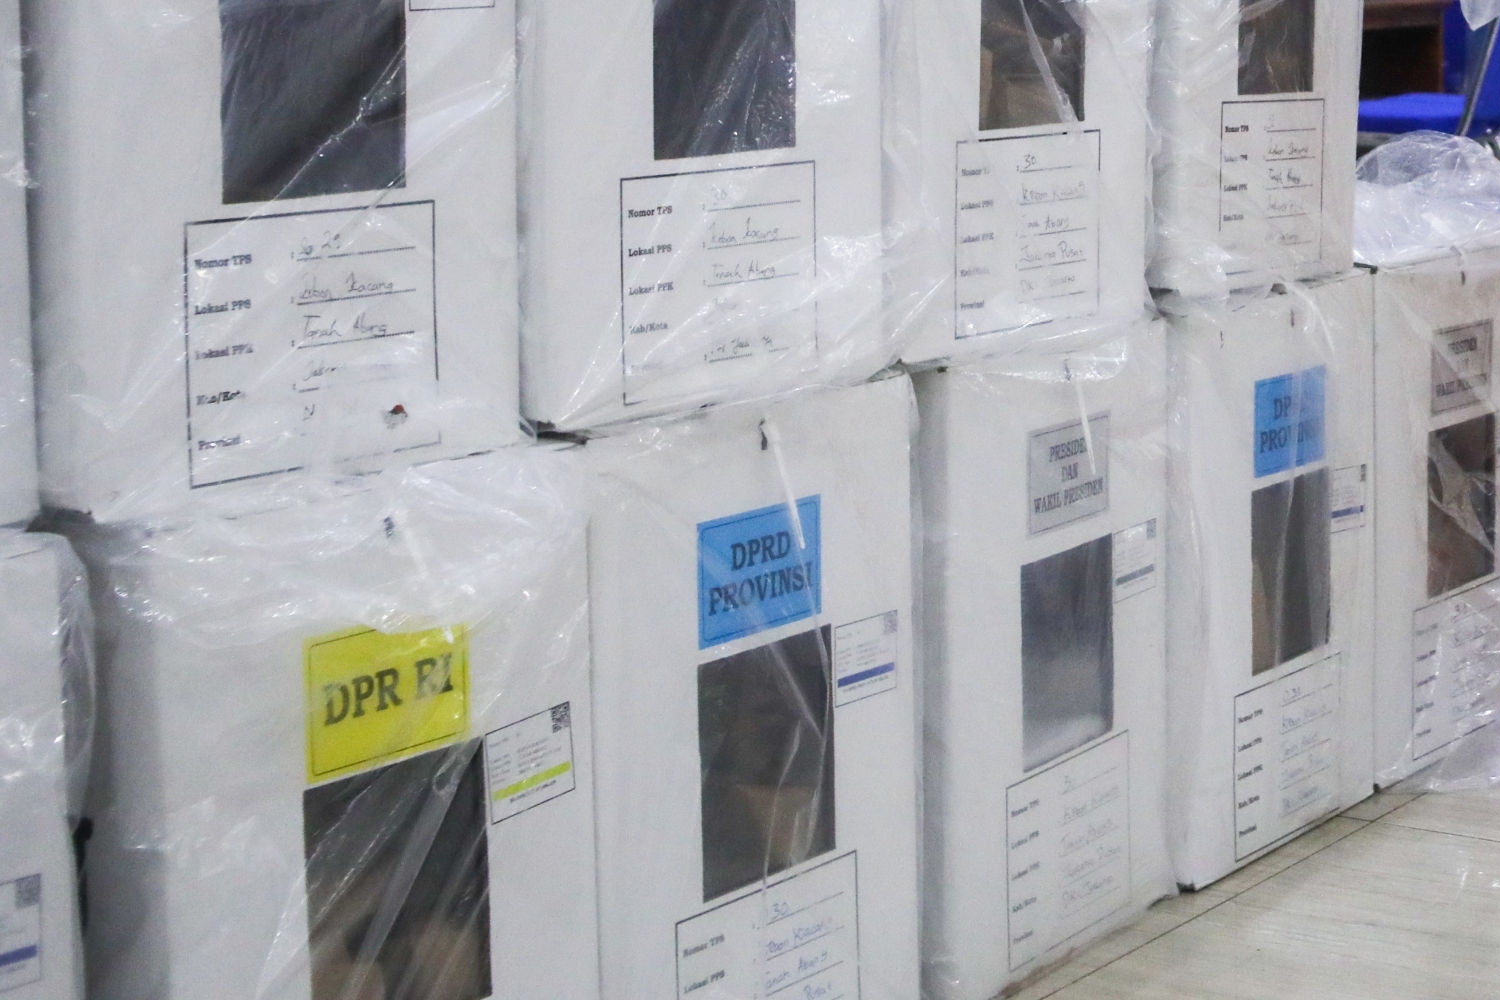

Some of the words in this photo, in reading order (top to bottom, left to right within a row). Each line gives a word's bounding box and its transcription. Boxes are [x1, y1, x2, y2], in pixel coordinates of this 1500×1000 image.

[627, 208, 655, 219] Nomor
[628, 245, 655, 258] Lokasi
[656, 243, 673, 255] PPS
[1048, 436, 1090, 463] PRESIDE
[1061, 462, 1079, 482] DAN
[730, 530, 791, 572] DPRD
[708, 560, 813, 617] PROVINSI
[323, 666, 404, 727] DPR
[415, 652, 454, 701] RI
